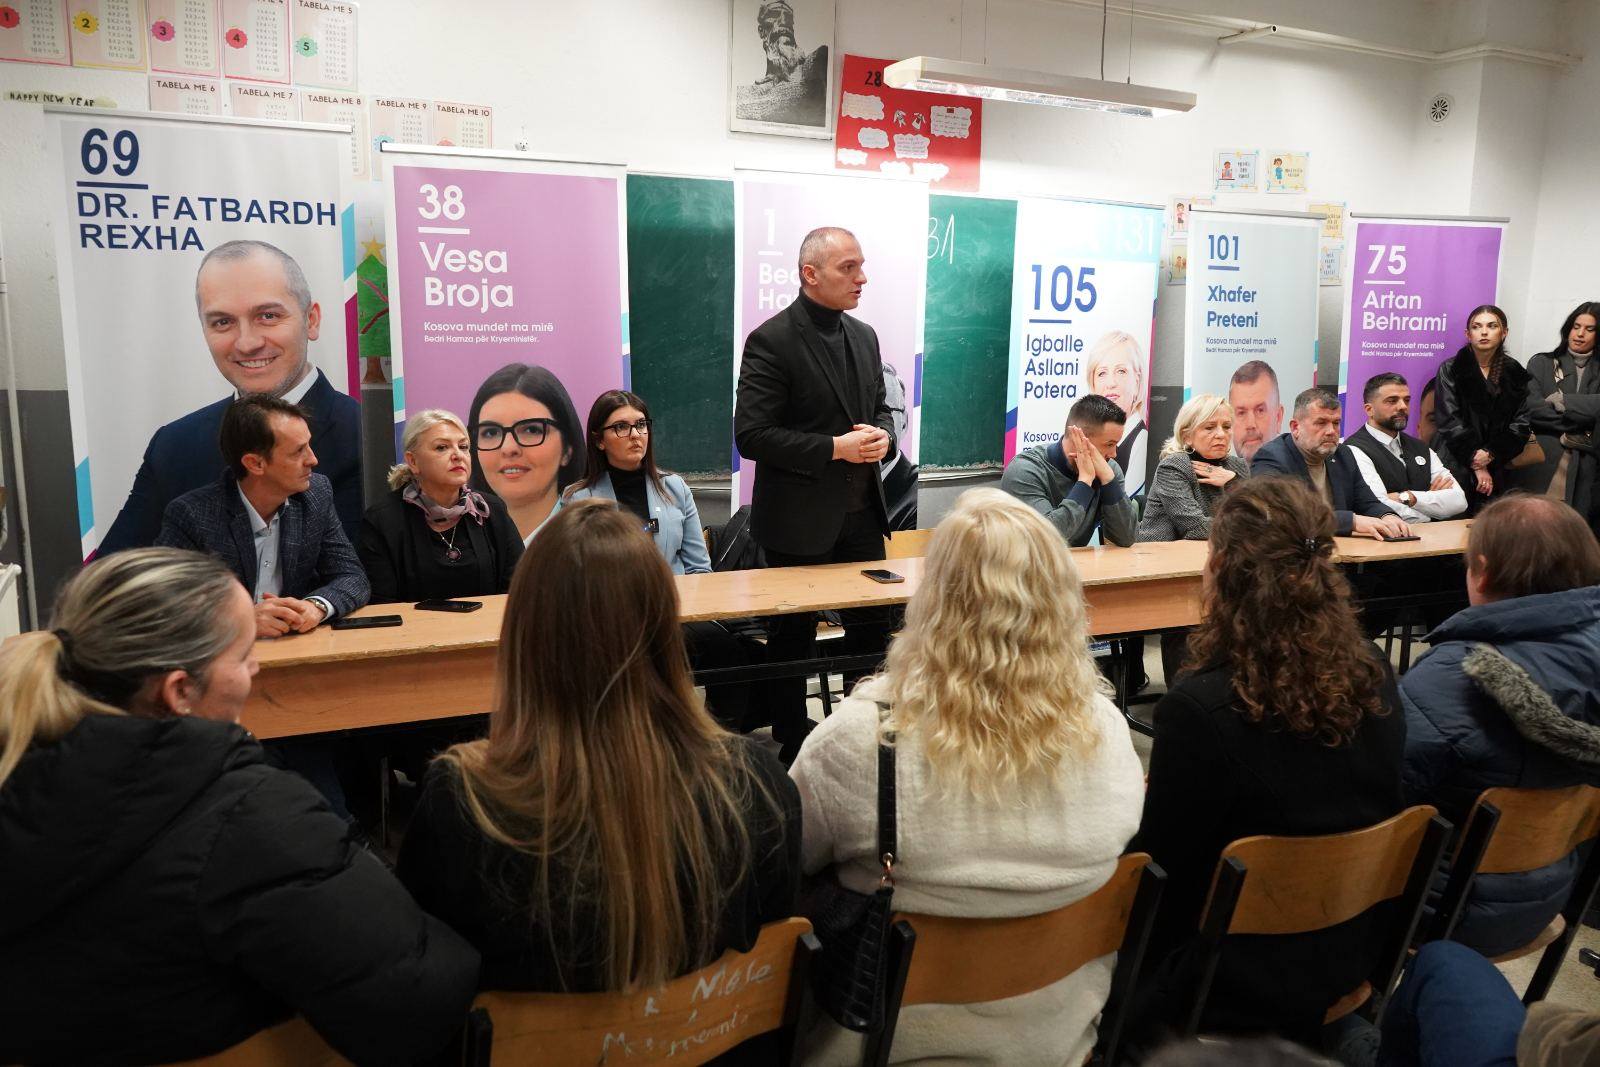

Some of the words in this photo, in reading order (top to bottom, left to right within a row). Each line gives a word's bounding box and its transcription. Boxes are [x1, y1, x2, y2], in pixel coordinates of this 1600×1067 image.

[300, 1, 330, 11] TABELA
[82, 18, 90, 28] 2
[160, 26, 167, 35] 3
[233, 33, 240, 42] 4
[303, 42, 310, 51] 5
[156, 80, 190, 90] TABELA
[193, 84, 207, 92] ME
[865, 71, 882, 87] 28
[10, 91, 39, 102] HAPPY
[43, 94, 64, 103] NEW
[238, 87, 270, 97] TABELA
[273, 91, 286, 99] ME
[307, 94, 339, 104] TABELA
[341, 97, 353, 105] ME
[376, 99, 405, 109] TABELA
[408, 102, 420, 110] ME
[436, 105, 465, 114] TABELA
[467, 108, 479, 116] ME
[481, 109, 490, 117] 10
[80, 128, 140, 177] 69
[76, 191, 139, 219] DR.
[151, 194, 337, 226] FATBARDH
[418, 183, 466, 221] 38
[763, 208, 776, 246] 1
[79, 223, 205, 251] REXHA
[1208, 234, 1239, 260] 101
[419, 241, 508, 274] Vesa
[1367, 244, 1407, 275] 75
[424, 276, 514, 314] Broja
[1031, 264, 1097, 313] 105
[1207, 285, 1257, 303] Xhafer
[758, 288, 799, 310] Ha
[1362, 289, 1422, 310] Artan
[424, 321, 464, 331] Kosova
[466, 322, 508, 332] mundet
[511, 323, 529, 332] ma
[531, 322, 554, 332] mirë
[1207, 310, 1258, 328] Preteni
[1362, 311, 1447, 332] Behrami
[1026, 334, 1084, 357] Igballe
[1206, 337, 1228, 345] Kosova
[1228, 337, 1252, 345] mundet
[1362, 341, 1388, 349] Kosova
[1024, 358, 1080, 377] Asllani
[1023, 380, 1077, 399] Potera
[1023, 431, 1059, 443] Kosova
